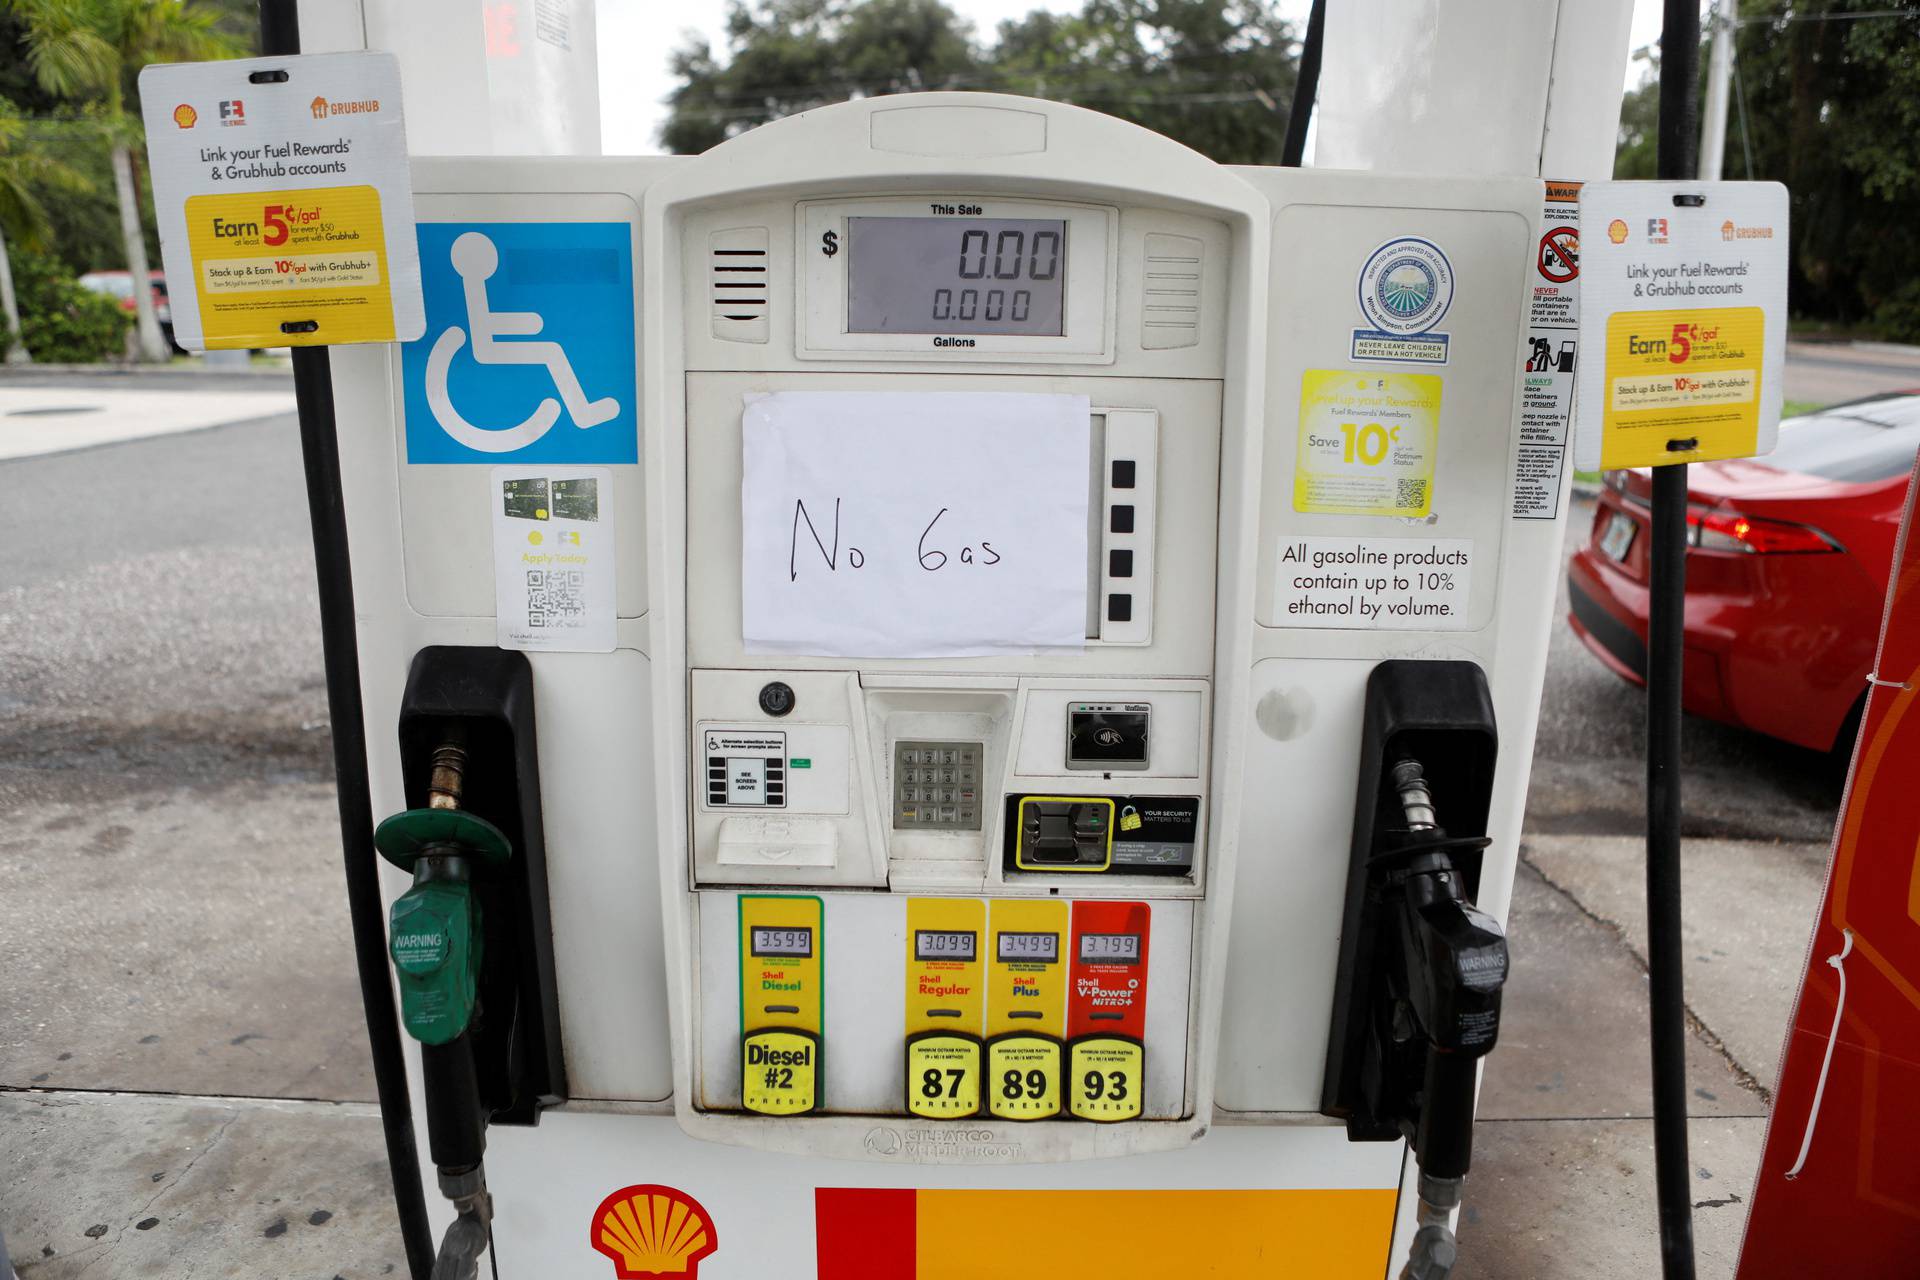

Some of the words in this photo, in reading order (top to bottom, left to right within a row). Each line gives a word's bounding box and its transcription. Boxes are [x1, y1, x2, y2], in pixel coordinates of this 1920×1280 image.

[331, 100, 380, 116] GRUBHUB
[201, 146, 227, 162] Link
[230, 149, 260, 164] your
[264, 143, 290, 158] Fuel
[211, 167, 222, 180] &
[226, 162, 286, 180] Grubhub
[289, 160, 346, 176] accounts
[931, 205, 955, 215] This
[958, 205, 982, 215] Sale
[213, 218, 258, 238] Earn
[311, 234, 324, 242] with
[325, 231, 360, 241] Grubhub
[822, 230, 838, 258] $
[959, 230, 1060, 280] 0.00
[1398, 246, 1424, 255] APPROVED
[1424, 250, 1434, 260] FOR
[210, 266, 231, 277] Stack
[234, 267, 244, 278] up
[246, 267, 253, 275] &
[254, 266, 274, 275] Earn
[309, 262, 327, 273] with
[1627, 264, 1649, 279] Link
[1653, 266, 1677, 281] your
[1680, 263, 1701, 277] Fuel
[1534, 287, 1559, 295] NEVER
[1634, 285, 1643, 297] &
[1646, 281, 1695, 297] Grubhub
[1698, 282, 1743, 295] accounts
[933, 289, 1031, 321] 0.000
[1406, 301, 1443, 329] Commissioner
[933, 337, 976, 348] Gallons
[1629, 335, 1666, 354] Earn
[1719, 350, 1745, 359] Grubhub
[1618, 386, 1637, 395] Stack
[1379, 410, 1412, 418] Members
[1308, 435, 1339, 447] Save
[1393, 452, 1422, 460] Platinum
[791, 498, 864, 581] No
[522, 553, 552, 564] Apply
[555, 553, 588, 565] Today
[1282, 543, 1307, 563] All
[1313, 544, 1388, 569] gasoline
[1394, 545, 1468, 570] products
[1293, 572, 1358, 589] contain
[1365, 577, 1387, 595] up
[1393, 575, 1409, 590] to
[1418, 573, 1454, 590] 10%
[1288, 595, 1353, 614] ethanol
[1360, 596, 1382, 620] by
[1388, 596, 1454, 616] volume.
[395, 933, 442, 948] WARNING
[762, 932, 808, 948] 3.599
[925, 935, 971, 950] 3.099
[1006, 936, 1051, 952] 3.499
[1087, 937, 1134, 953] 3.799
[1459, 954, 1505, 971] WARNING
[762, 971, 784, 980] Shell
[919, 976, 941, 984] Shell
[1013, 977, 1035, 986] Shell
[1077, 978, 1099, 987] Shell
[762, 980, 801, 991] Diesel
[919, 984, 970, 997] Regular
[1013, 986, 1040, 997] Plus
[1077, 986, 1133, 998] V-Power
[748, 1044, 810, 1066] Diesel
[764, 1068, 793, 1089] #2
[921, 1068, 966, 1098] 87
[1002, 1069, 1047, 1100] 89
[1083, 1070, 1128, 1101] 93
[904, 1129, 994, 1142] GILBARCO
